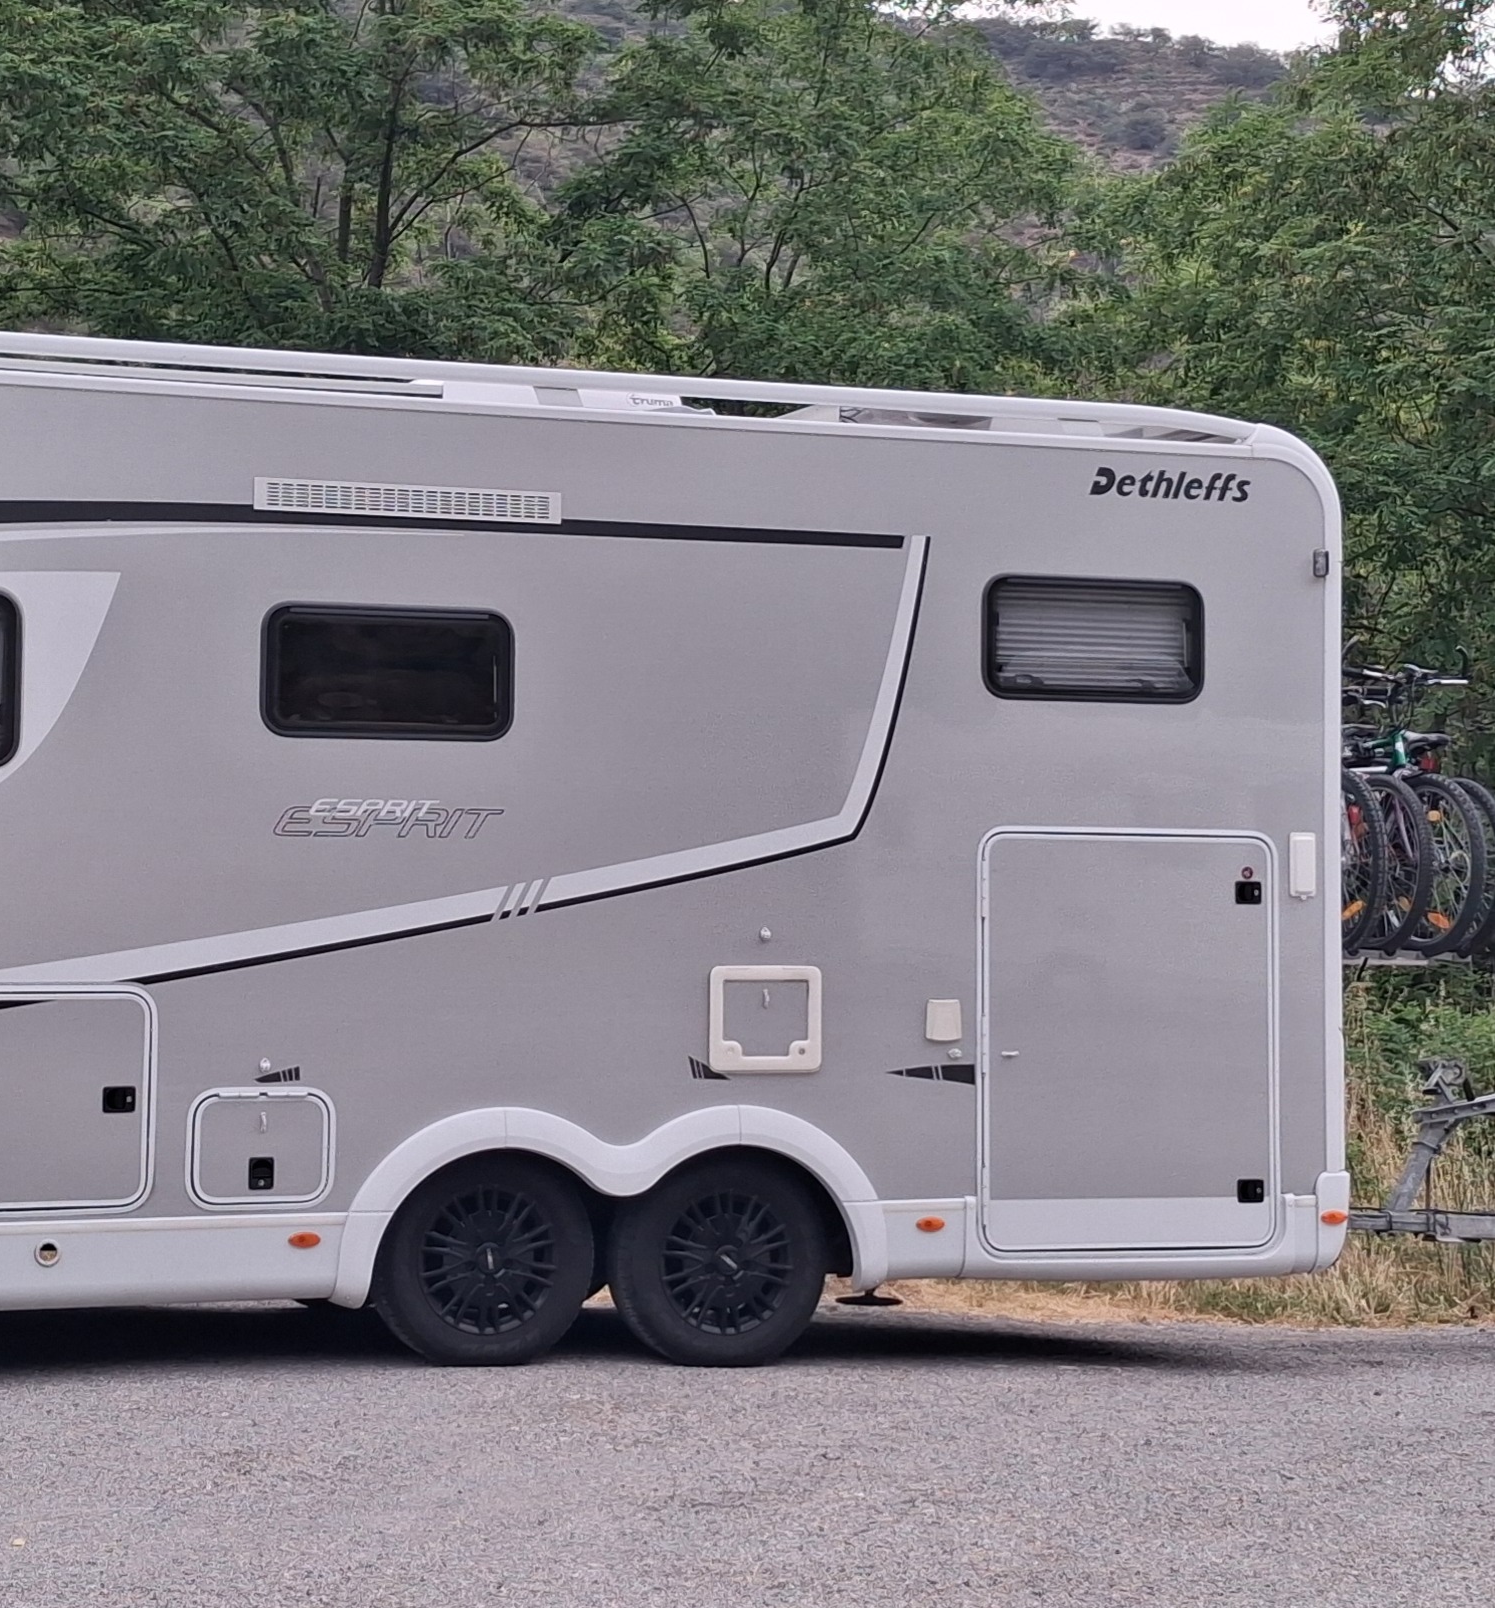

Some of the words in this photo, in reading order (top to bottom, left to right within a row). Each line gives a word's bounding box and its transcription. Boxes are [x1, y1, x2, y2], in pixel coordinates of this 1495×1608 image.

[1089, 466, 1252, 503] Dethleffs
[273, 805, 505, 839] ESPRIT
[309, 798, 441, 817] ESPRIT
